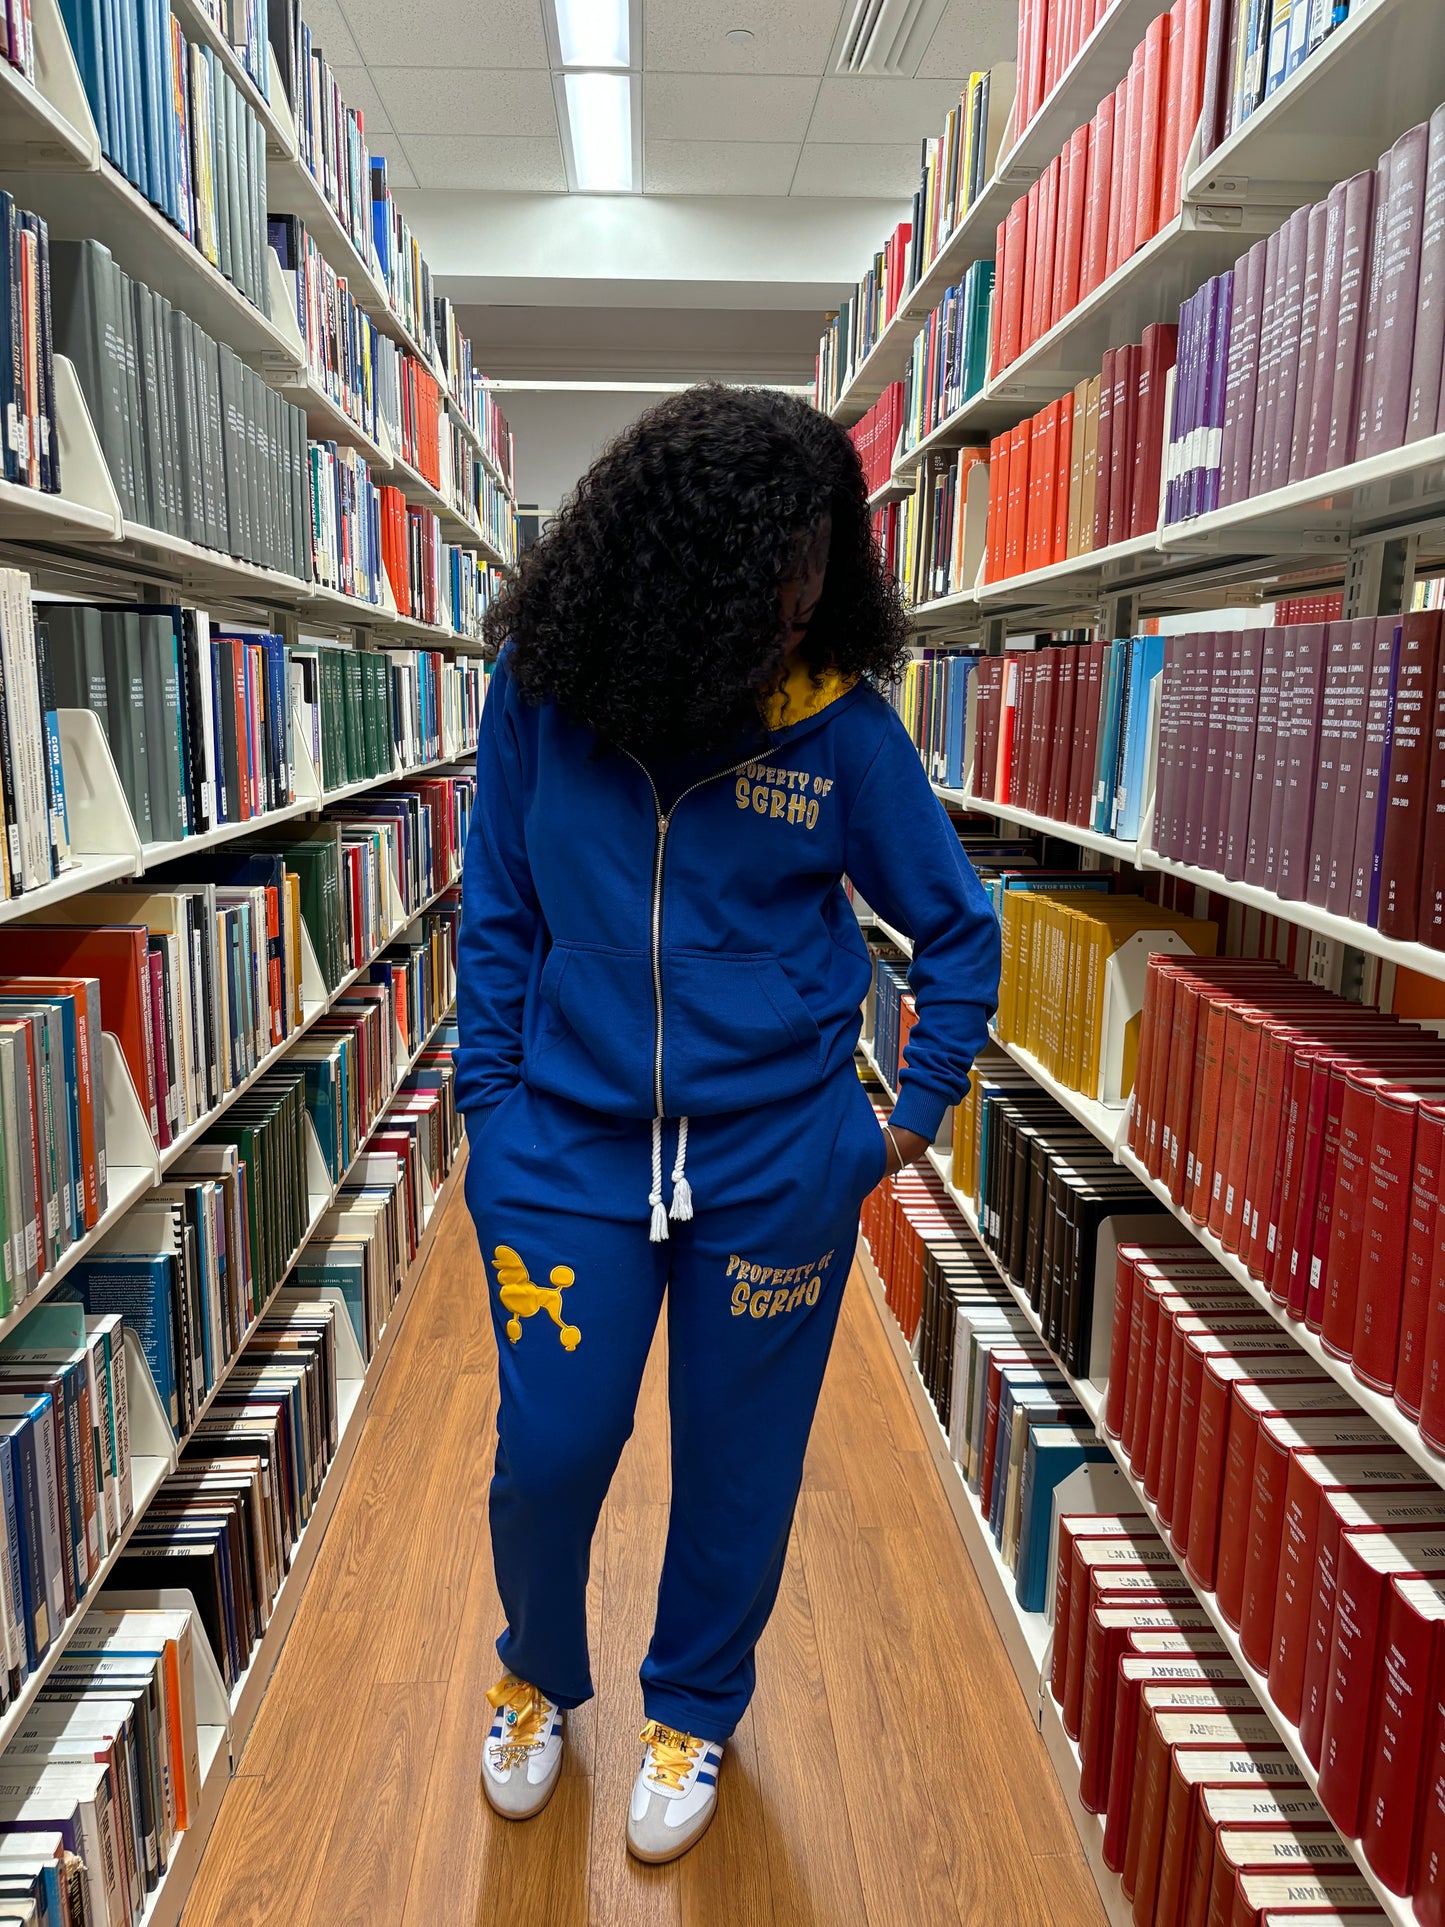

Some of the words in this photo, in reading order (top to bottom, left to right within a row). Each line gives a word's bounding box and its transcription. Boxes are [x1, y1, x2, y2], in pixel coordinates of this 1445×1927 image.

[1407, 666, 1422, 674] JOURNAL
[1407, 678, 1412, 686] OF
[1397, 702, 1421, 711] MATHEMATICS
[1, 694, 10, 755] Architecture
[1402, 714, 1411, 723] AND
[52, 735, 60, 764] COM
[1395, 738, 1415, 748] COMPUTING
[4, 757, 13, 795] Manual
[736, 762, 810, 791] ROPERTY
[813, 776, 834, 797] OF
[735, 777, 819, 830] SGRHO
[1290, 1099, 1298, 1125] JOURNAL
[1345, 1127, 1358, 1142] JOURNAL
[1347, 1140, 1353, 1148] OF
[1286, 1134, 1295, 1174] COMBINATORIAL
[1376, 1144, 1392, 1159] JOURNAL
[1342, 1158, 1355, 1172] THEORY
[1379, 1157, 1386, 1166] OF
[1370, 1162, 1399, 1184] COMBINATORIAL
[1417, 1163, 1434, 1179] JOURNAL
[1374, 1176, 1389, 1190] THEORY
[1420, 1176, 1426, 1186] OF
[1372, 1196, 1384, 1210] SERIES
[1383, 1204, 1388, 1213] A
[1415, 1196, 1430, 1211] THEORY
[1412, 1217, 1425, 1232] SERIES
[1424, 1226, 1430, 1235] A
[1371, 1229, 1382, 1243] 20-21
[1369, 1250, 1379, 1263] 1976
[725, 1254, 816, 1286] PROPERTY
[817, 1249, 835, 1271] OF
[1410, 1275, 1420, 1287] 1977
[730, 1276, 822, 1319] SGRHO
[113, 1356, 122, 1405] Backup
[101, 1376, 109, 1404] SQL
[69, 1404, 78, 1466] CLIENT/SERVER
[74, 1400, 82, 1463] IMPLEMENTING
[103, 1404, 112, 1460] SERVER
[42, 1420, 52, 1478] Client/Server
[47, 1480, 56, 1535] Architecture
[1362, 1470, 1406, 1479] LIBRARY
[1387, 1508, 1432, 1516] LIBRARY
[1128, 1551, 1171, 1560] LIBRARY
[1156, 1618, 1202, 1626] LIBRARY
[1152, 1667, 1200, 1678] LIBRARY
[1203, 1668, 1224, 1678] UM
[1171, 1693, 1218, 1705] LIBRARY
[1229, 1762, 1285, 1775] LIBRARY
[1253, 1803, 1309, 1813] LIBRARY
[1272, 1844, 1332, 1857] LIBRARY
[1287, 1888, 1346, 1900] LIBRARY
